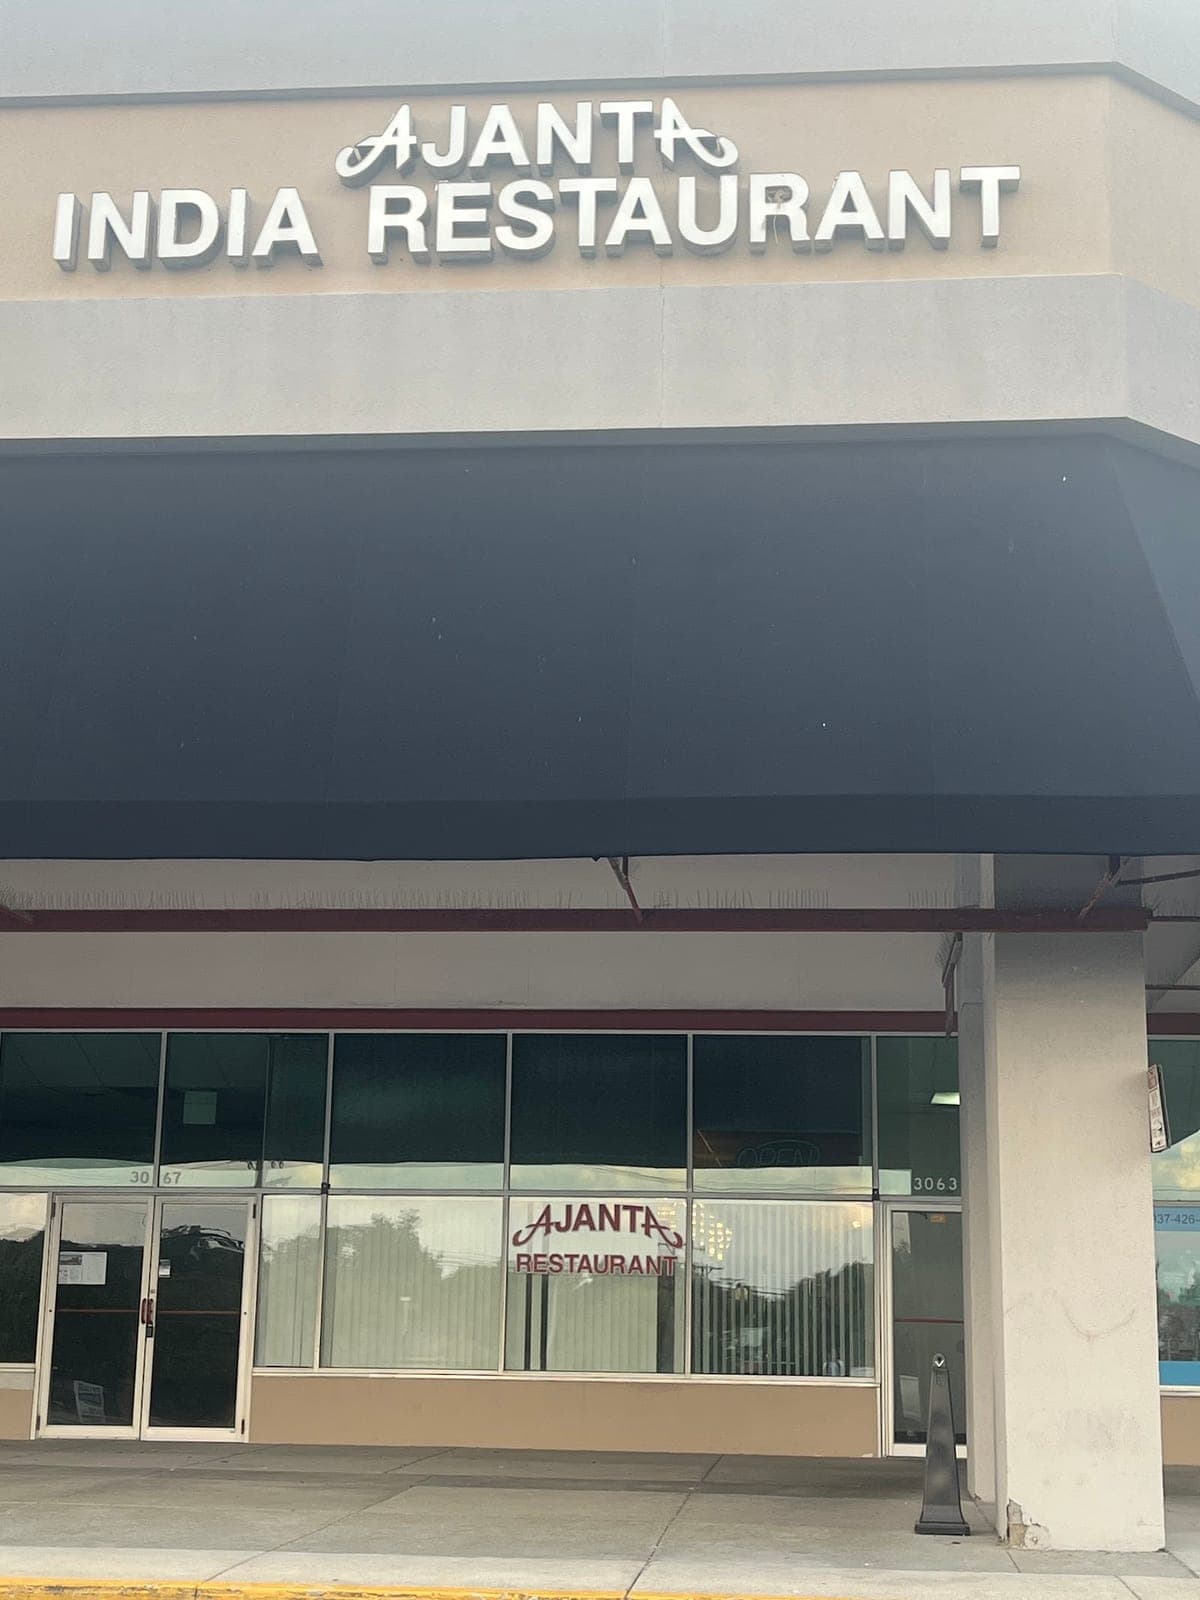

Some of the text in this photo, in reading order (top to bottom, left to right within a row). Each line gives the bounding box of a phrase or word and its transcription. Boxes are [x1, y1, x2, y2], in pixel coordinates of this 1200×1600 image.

[335, 97, 738, 184] AJANTA
[53, 165, 1020, 268] INDIA RESTAURANT
[737, 1145, 814, 1167] OPEN
[913, 1177, 957, 1191] 3063
[512, 1203, 683, 1249] AJANTA
[516, 1253, 678, 1275] RESTAURANT
